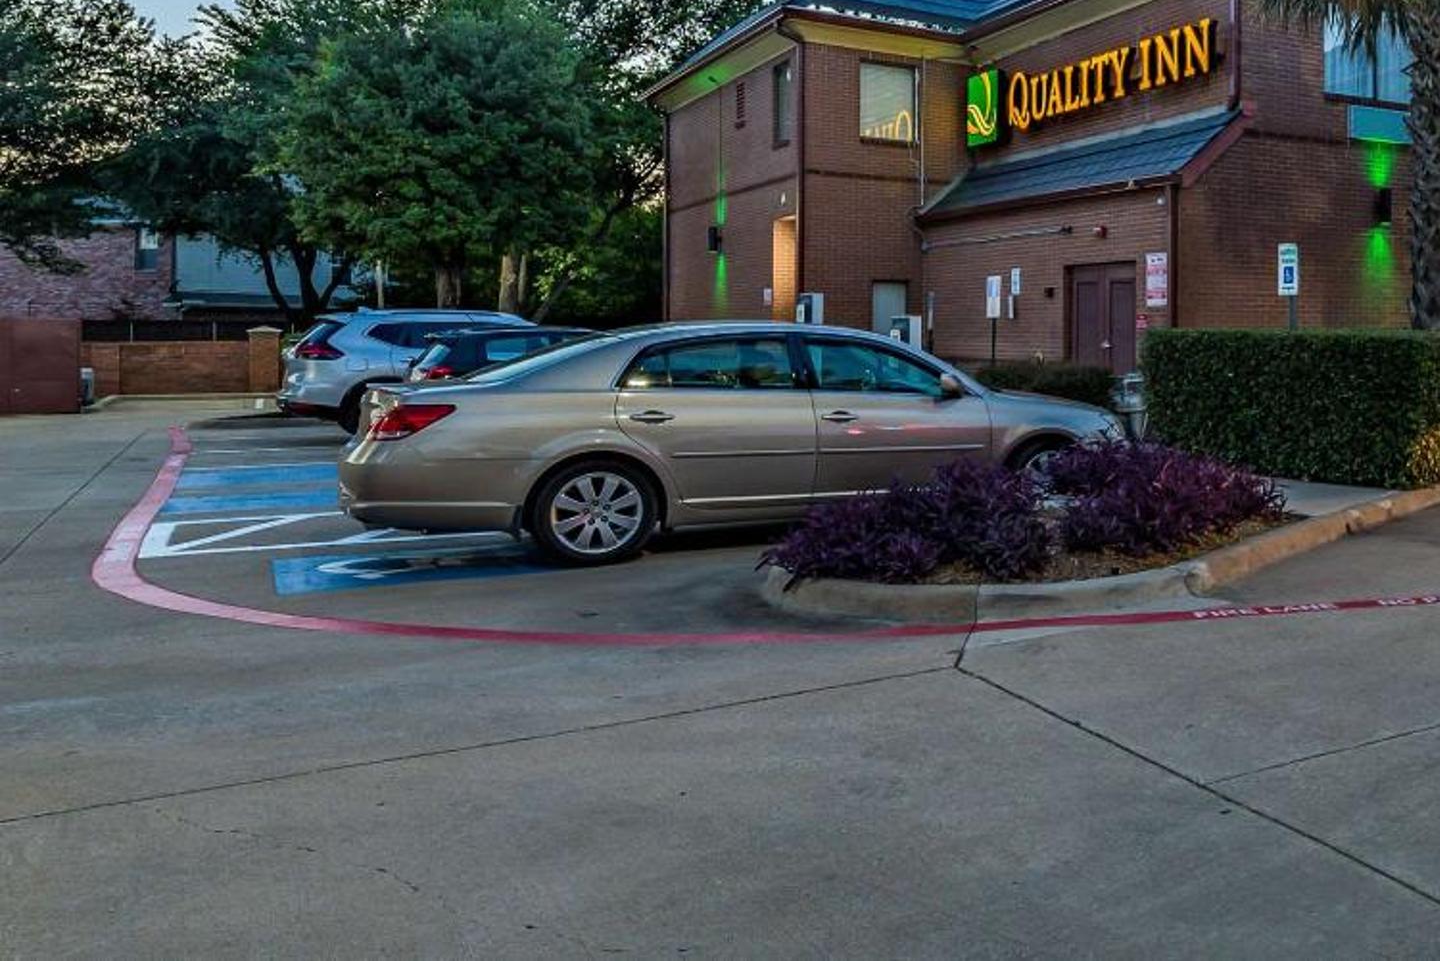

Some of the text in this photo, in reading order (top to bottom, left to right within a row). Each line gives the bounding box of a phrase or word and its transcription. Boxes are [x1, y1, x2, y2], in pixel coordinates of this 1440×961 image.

[1008, 18, 1211, 130] QUALITY INN
[1263, 601, 1340, 615] LANE
[1377, 597, 1416, 607] NO
